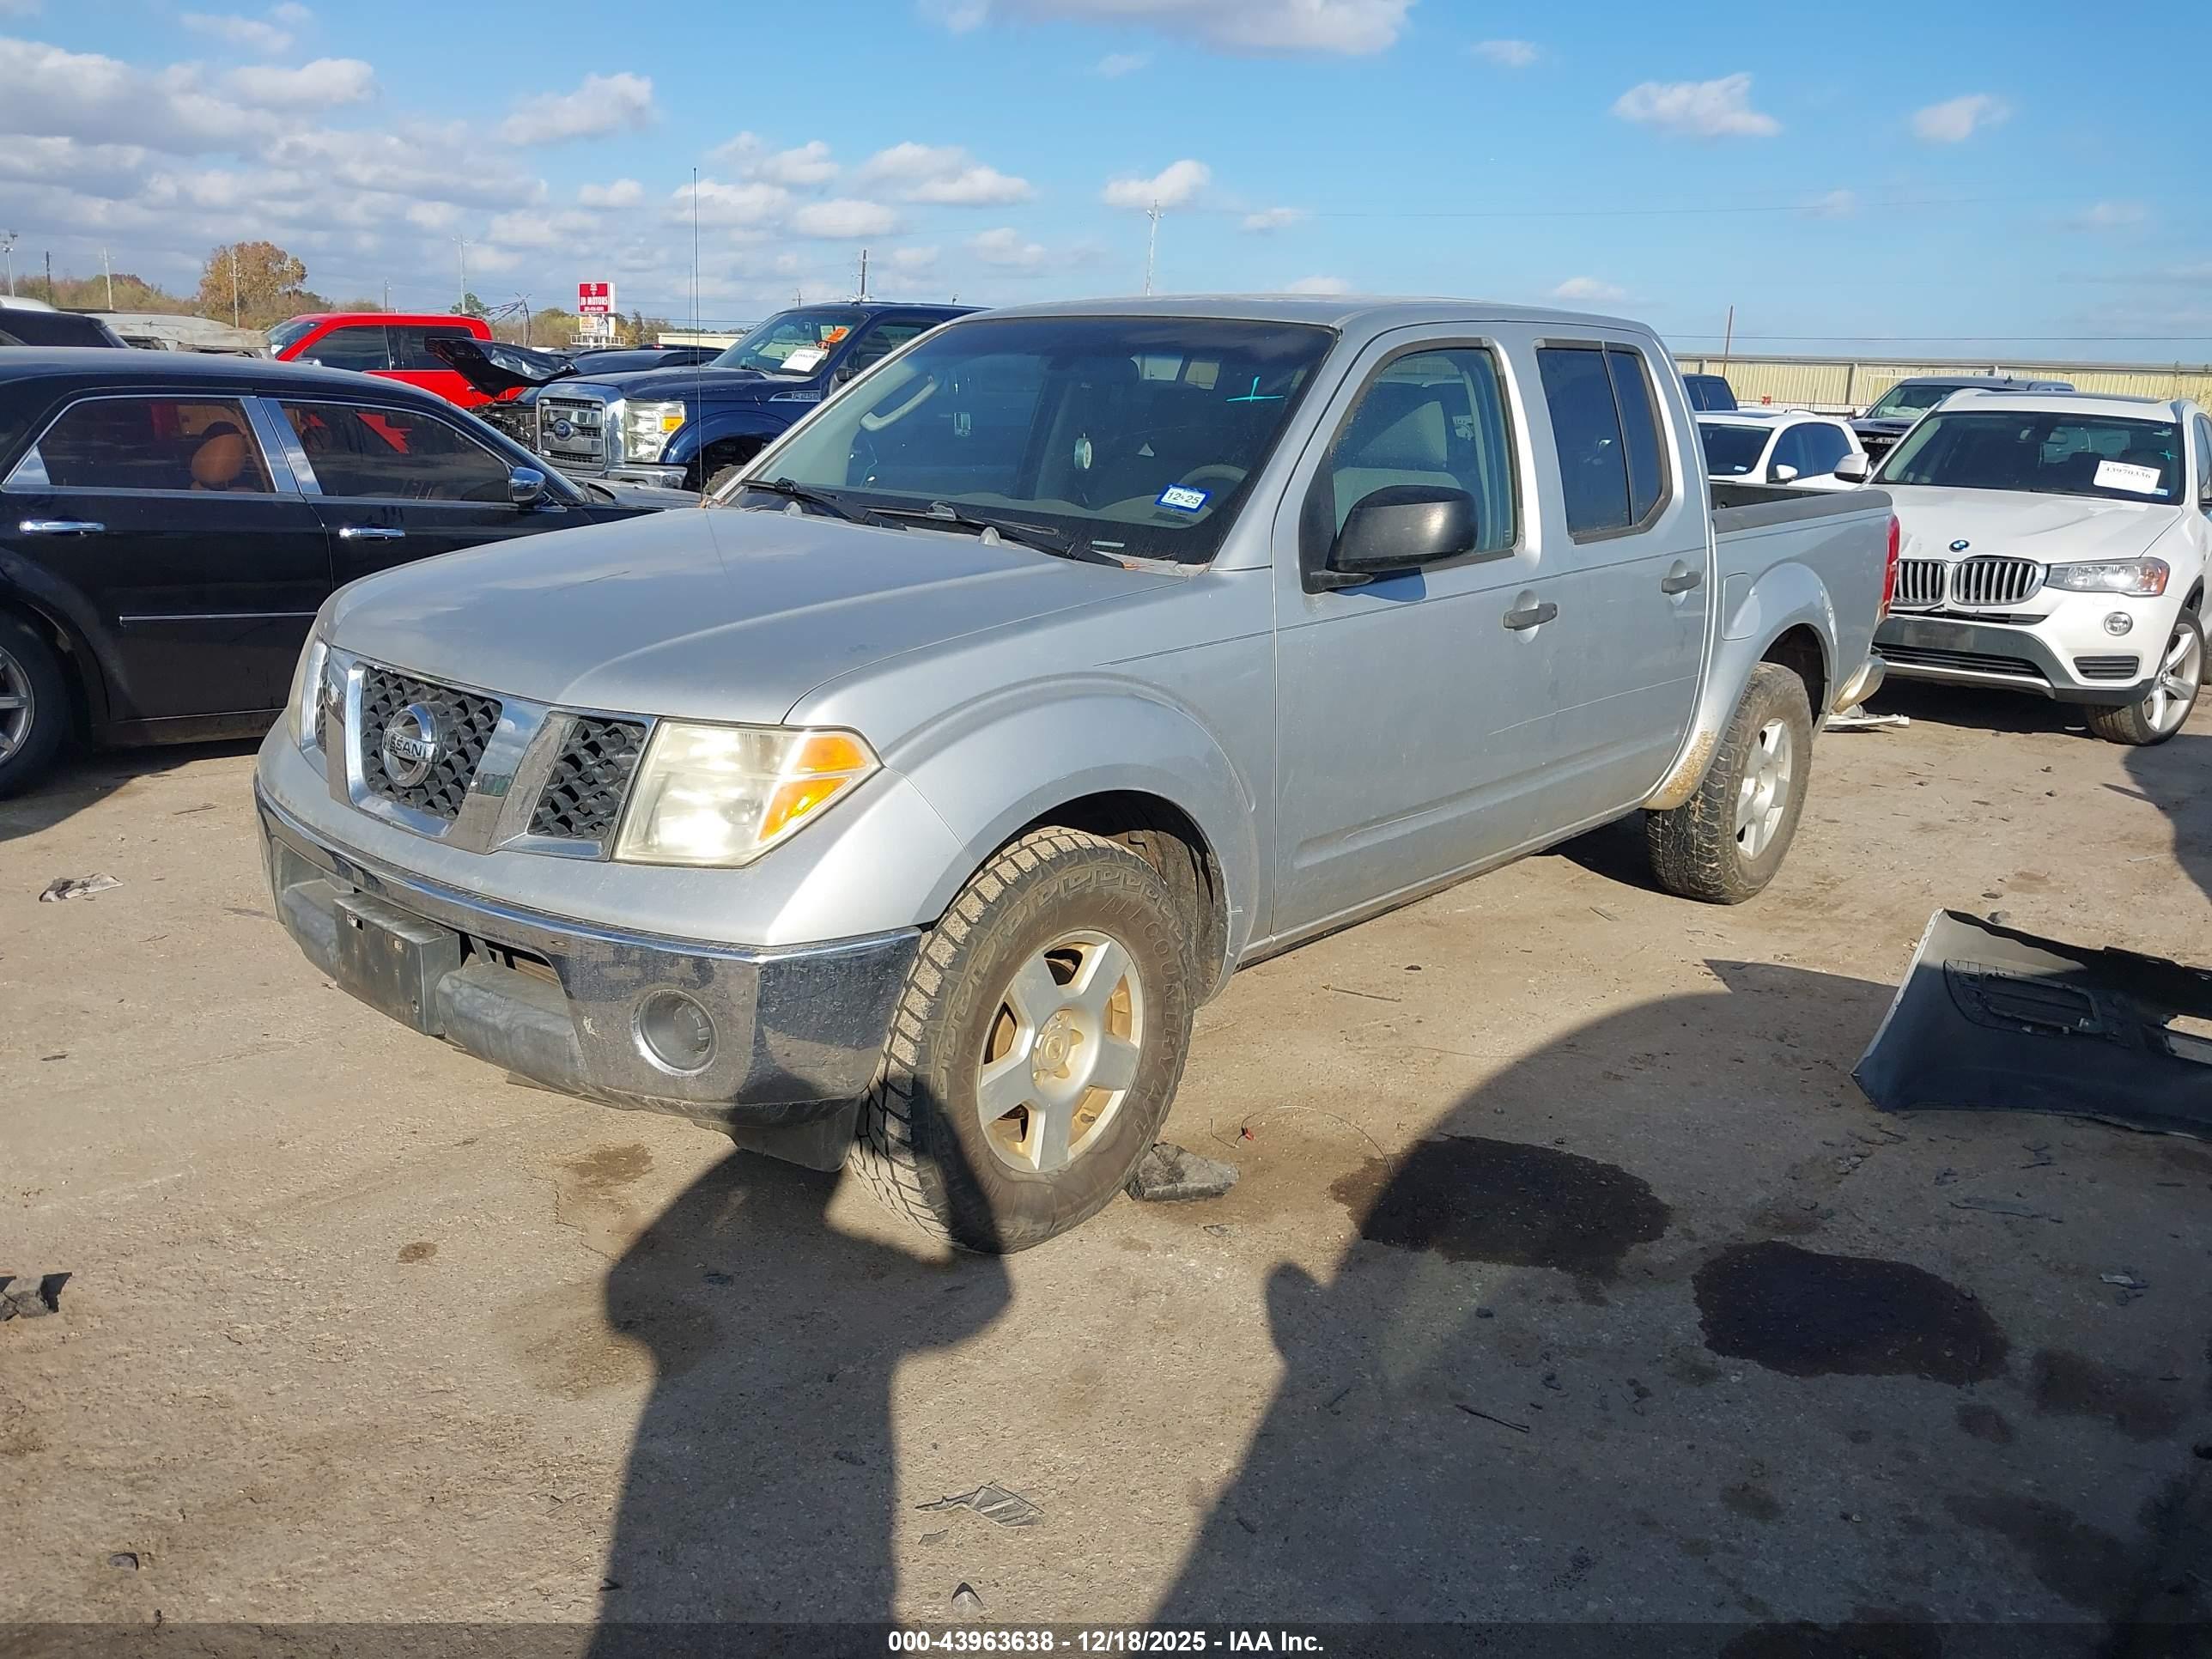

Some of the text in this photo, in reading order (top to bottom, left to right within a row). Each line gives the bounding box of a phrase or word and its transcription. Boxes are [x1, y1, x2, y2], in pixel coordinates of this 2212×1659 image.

[586, 296, 608, 306] MOTORS
[1184, 495, 1201, 505] 25
[384, 730, 425, 758] NISSAN
